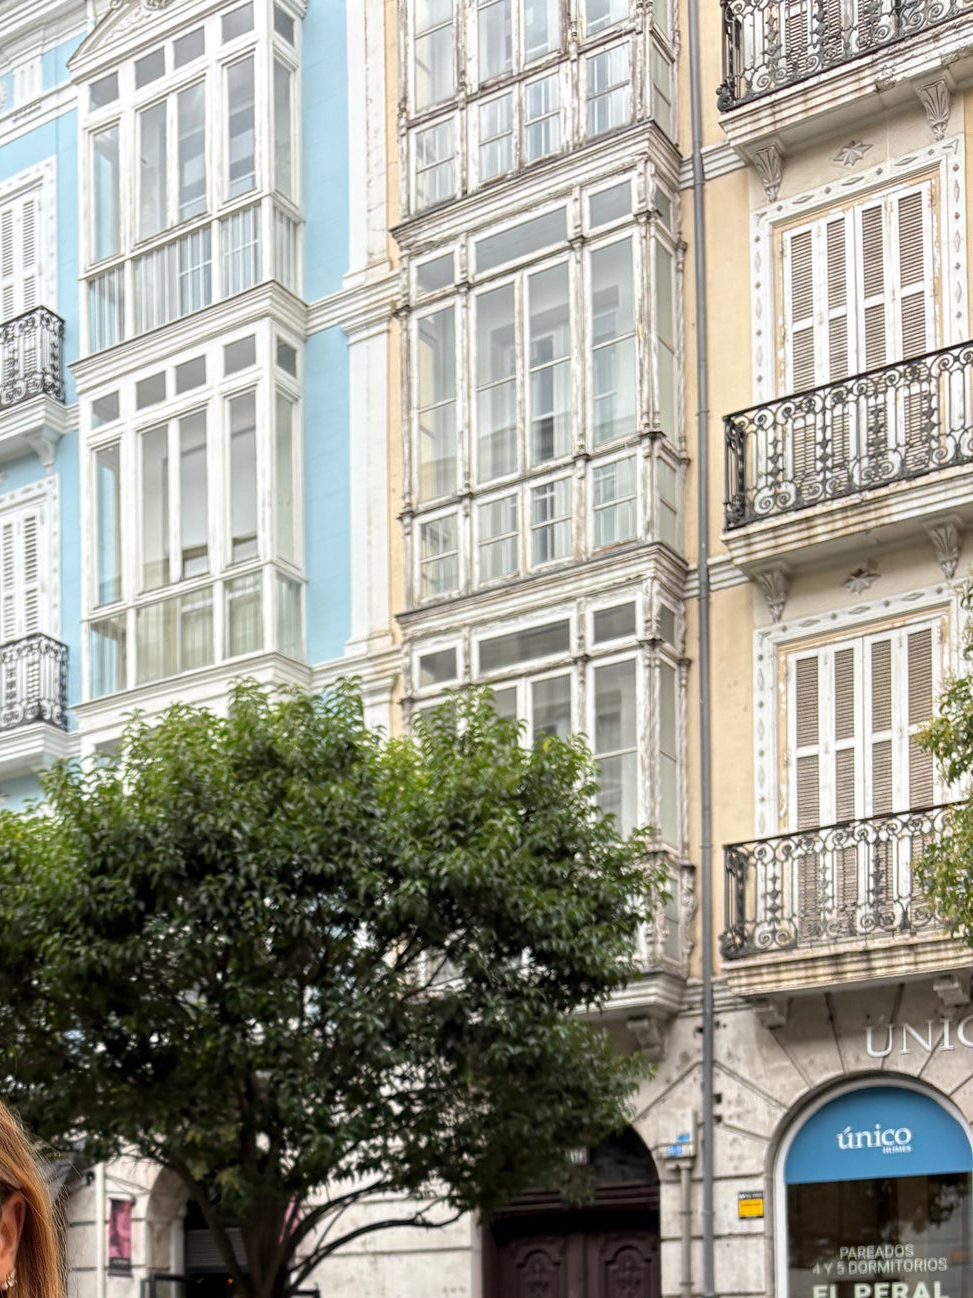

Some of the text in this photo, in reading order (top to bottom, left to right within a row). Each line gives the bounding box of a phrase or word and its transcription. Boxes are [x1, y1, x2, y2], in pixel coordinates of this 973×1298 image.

[836, 1123, 912, 1150] único
[839, 1244, 915, 1260] PAREADOS
[812, 1257, 948, 1275] 4 Y 5 DORMITORIOS
